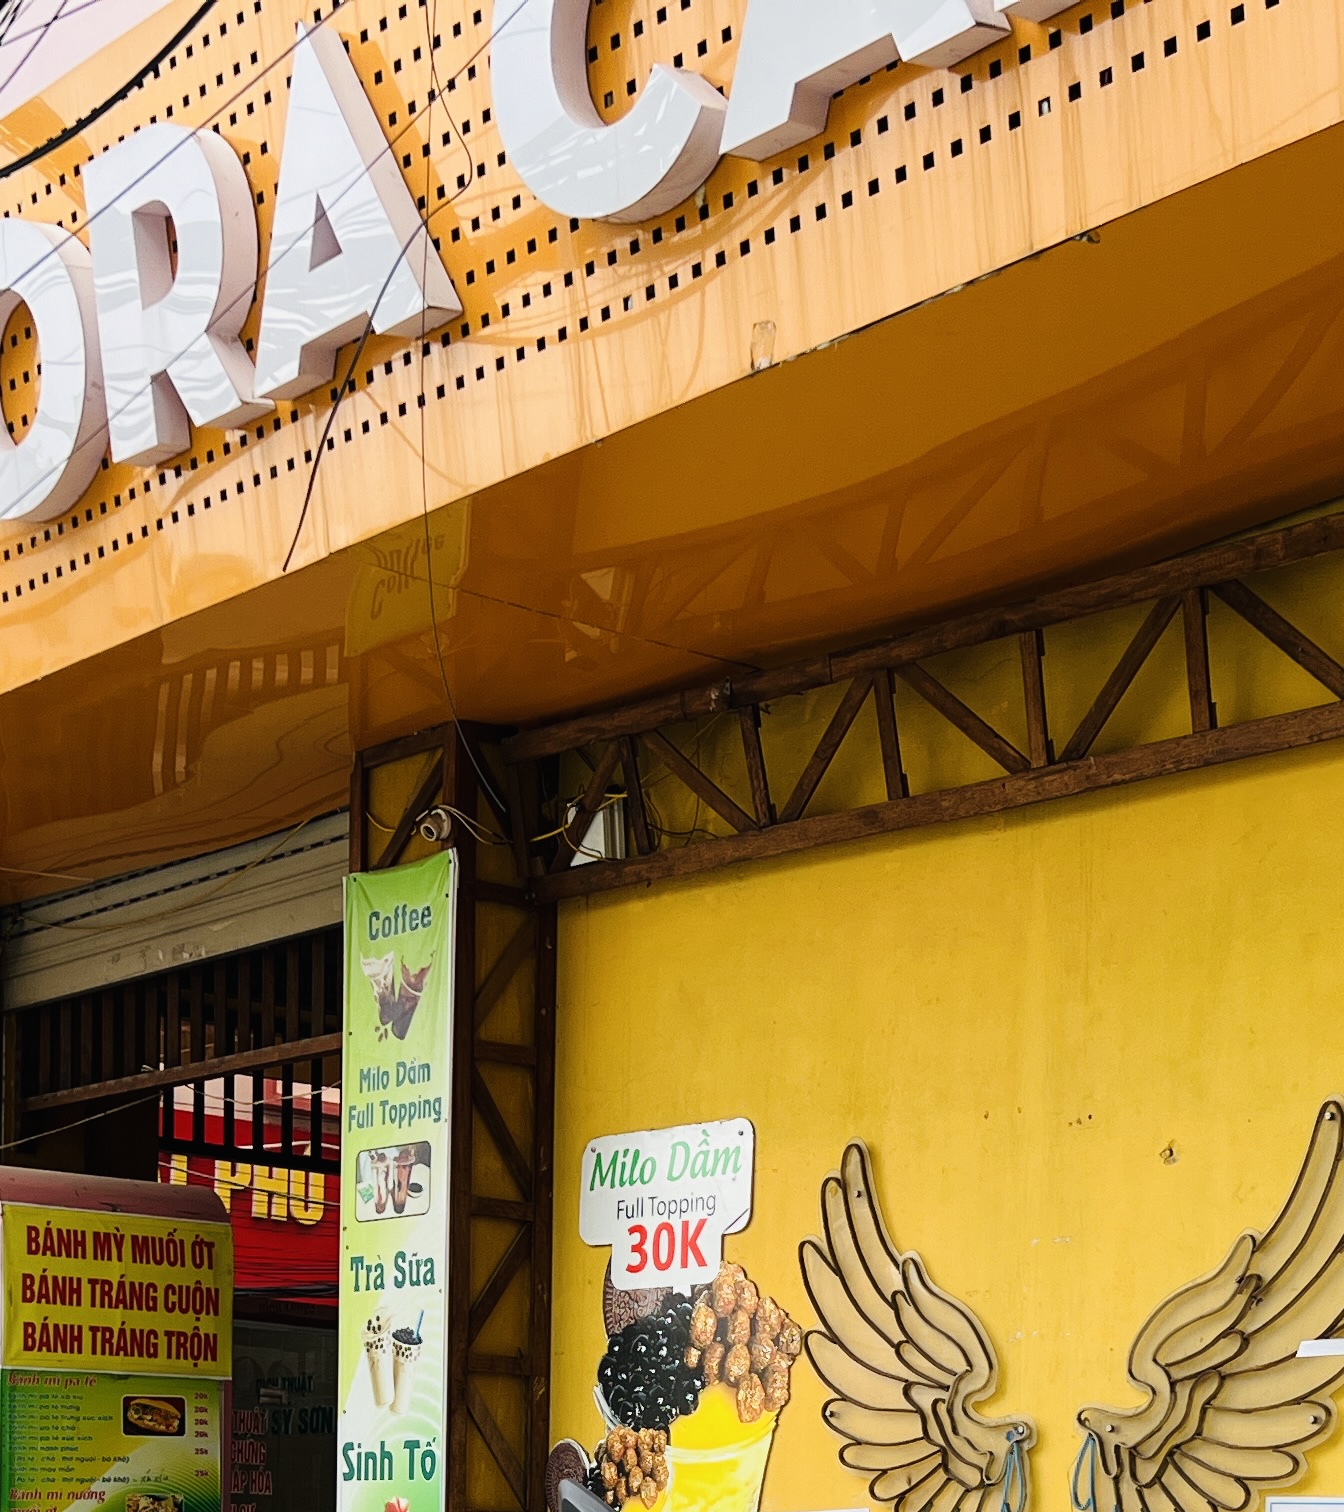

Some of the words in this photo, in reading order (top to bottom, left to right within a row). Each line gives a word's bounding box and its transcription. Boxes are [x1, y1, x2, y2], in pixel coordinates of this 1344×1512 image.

[369, 904, 432, 941] Coffee
[359, 1066, 390, 1094] Milo
[348, 1101, 374, 1133] Full
[379, 1096, 443, 1129] Topping
[589, 1148, 657, 1192] Milo
[666, 1129, 742, 1182] Dầm
[616, 1196, 644, 1221] Full
[648, 1191, 716, 1221] Topping
[26, 1220, 87, 1260] BÁNH
[92, 1226, 126, 1263] MỲ
[130, 1228, 186, 1268] MUỐI
[190, 1234, 215, 1270] ỚT
[625, 1217, 708, 1274] 30K
[350, 1254, 385, 1292] Trà
[393, 1250, 435, 1289] Sữa
[21, 1268, 82, 1307] BÁNH
[87, 1273, 158, 1313] TRÁNG
[163, 1279, 220, 1322] CUỘN
[22, 1316, 84, 1355] BÁNH
[88, 1321, 159, 1360] TRÁNG
[164, 1325, 218, 1368] TRỘN
[342, 1440, 393, 1482] Sinh
[403, 1437, 436, 1481] Tố
